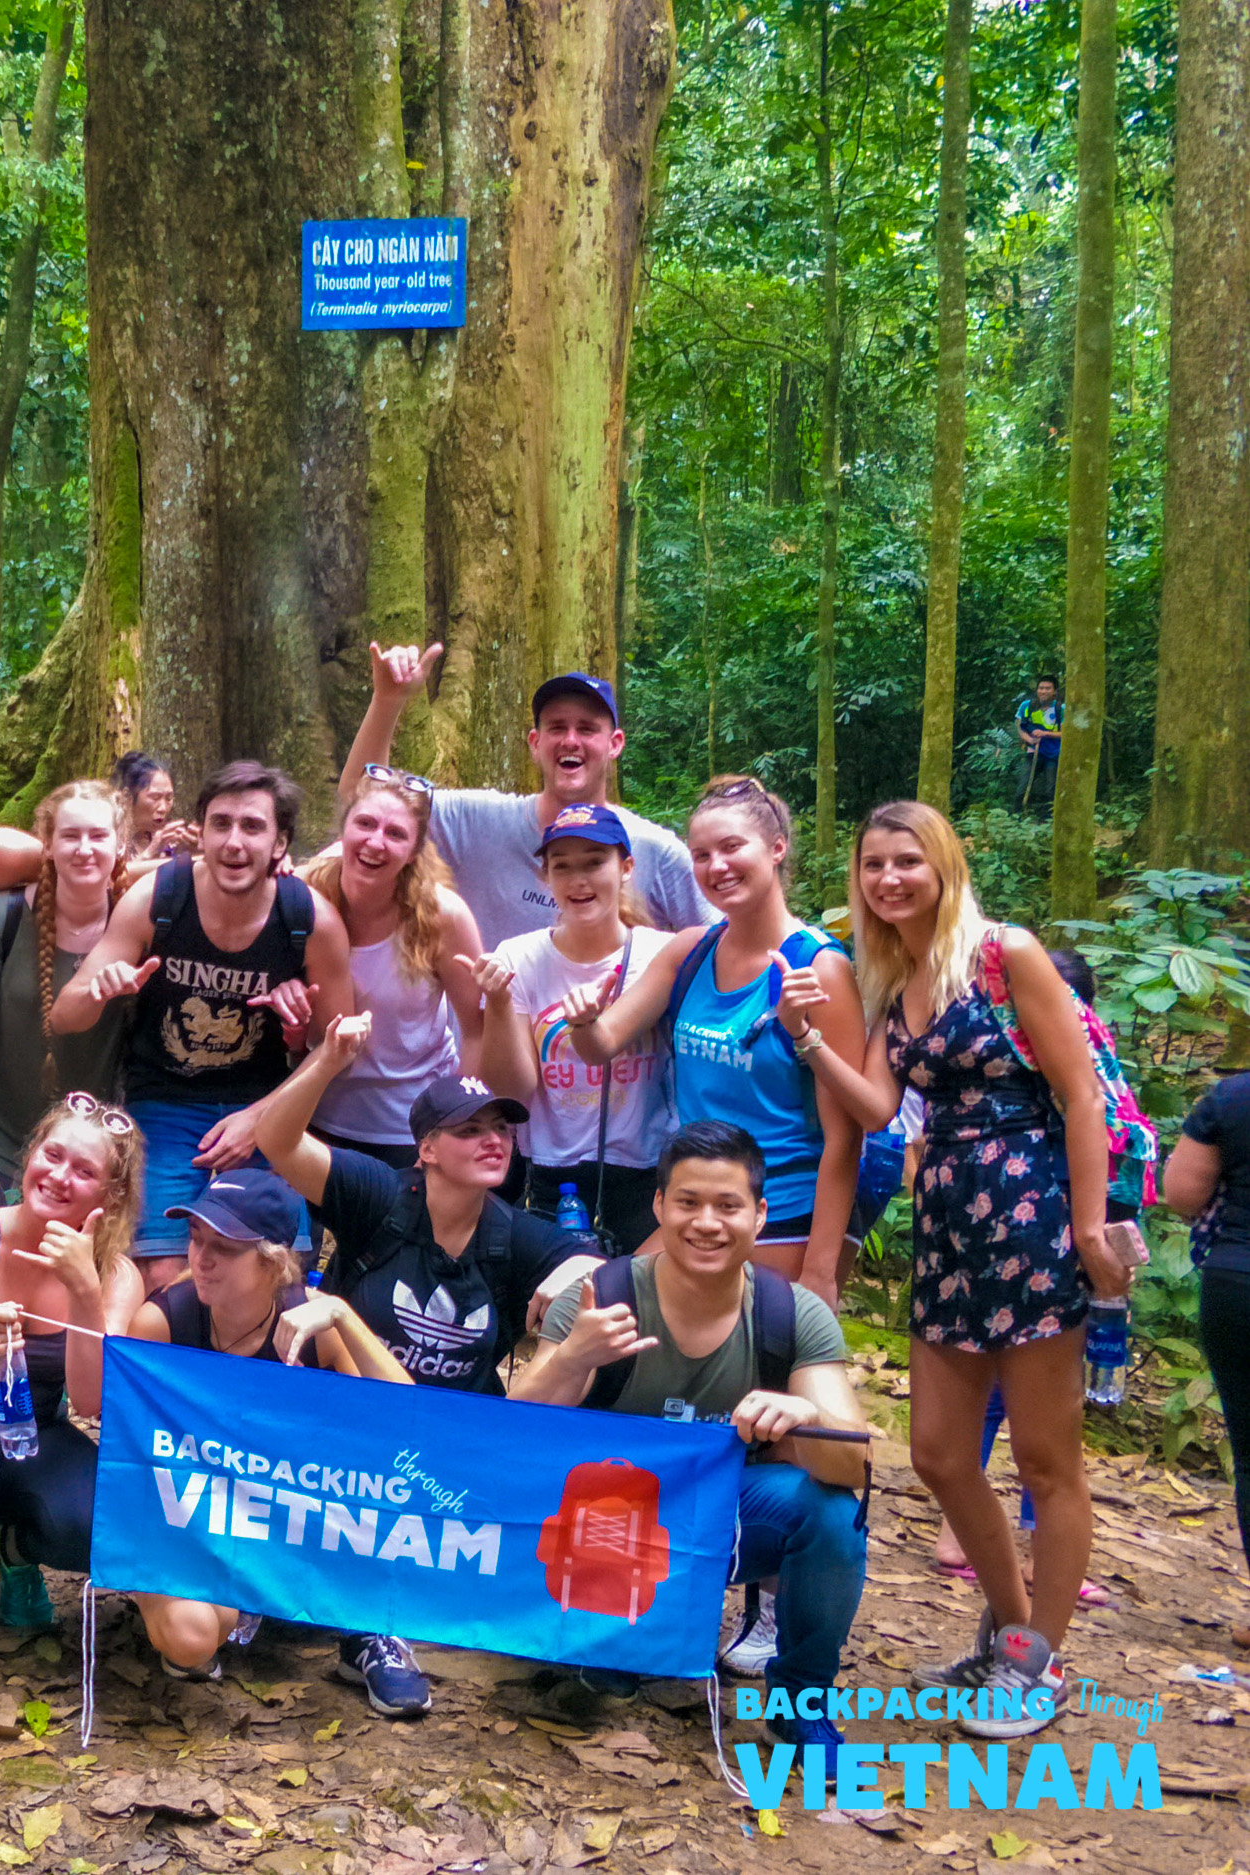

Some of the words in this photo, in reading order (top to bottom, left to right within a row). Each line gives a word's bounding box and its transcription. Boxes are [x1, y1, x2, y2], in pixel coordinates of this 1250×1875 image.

[312, 235, 340, 266] CÂY
[344, 232, 374, 265] CHÒ
[378, 232, 420, 264] NGÀN
[424, 230, 459, 262] NĂM
[314, 272, 371, 291] Thousand
[429, 272, 452, 287] tree
[310, 302, 378, 317] (Terminalia
[381, 300, 453, 317] myriocarpa)
[166, 957, 269, 997] SINGHA
[676, 1034, 753, 1072] ETNAM
[543, 1063, 574, 1089] EY
[152, 1429, 412, 1504] BACKPACKING
[393, 1448, 469, 1514] through
[152, 1466, 502, 1576] VIETNAM
